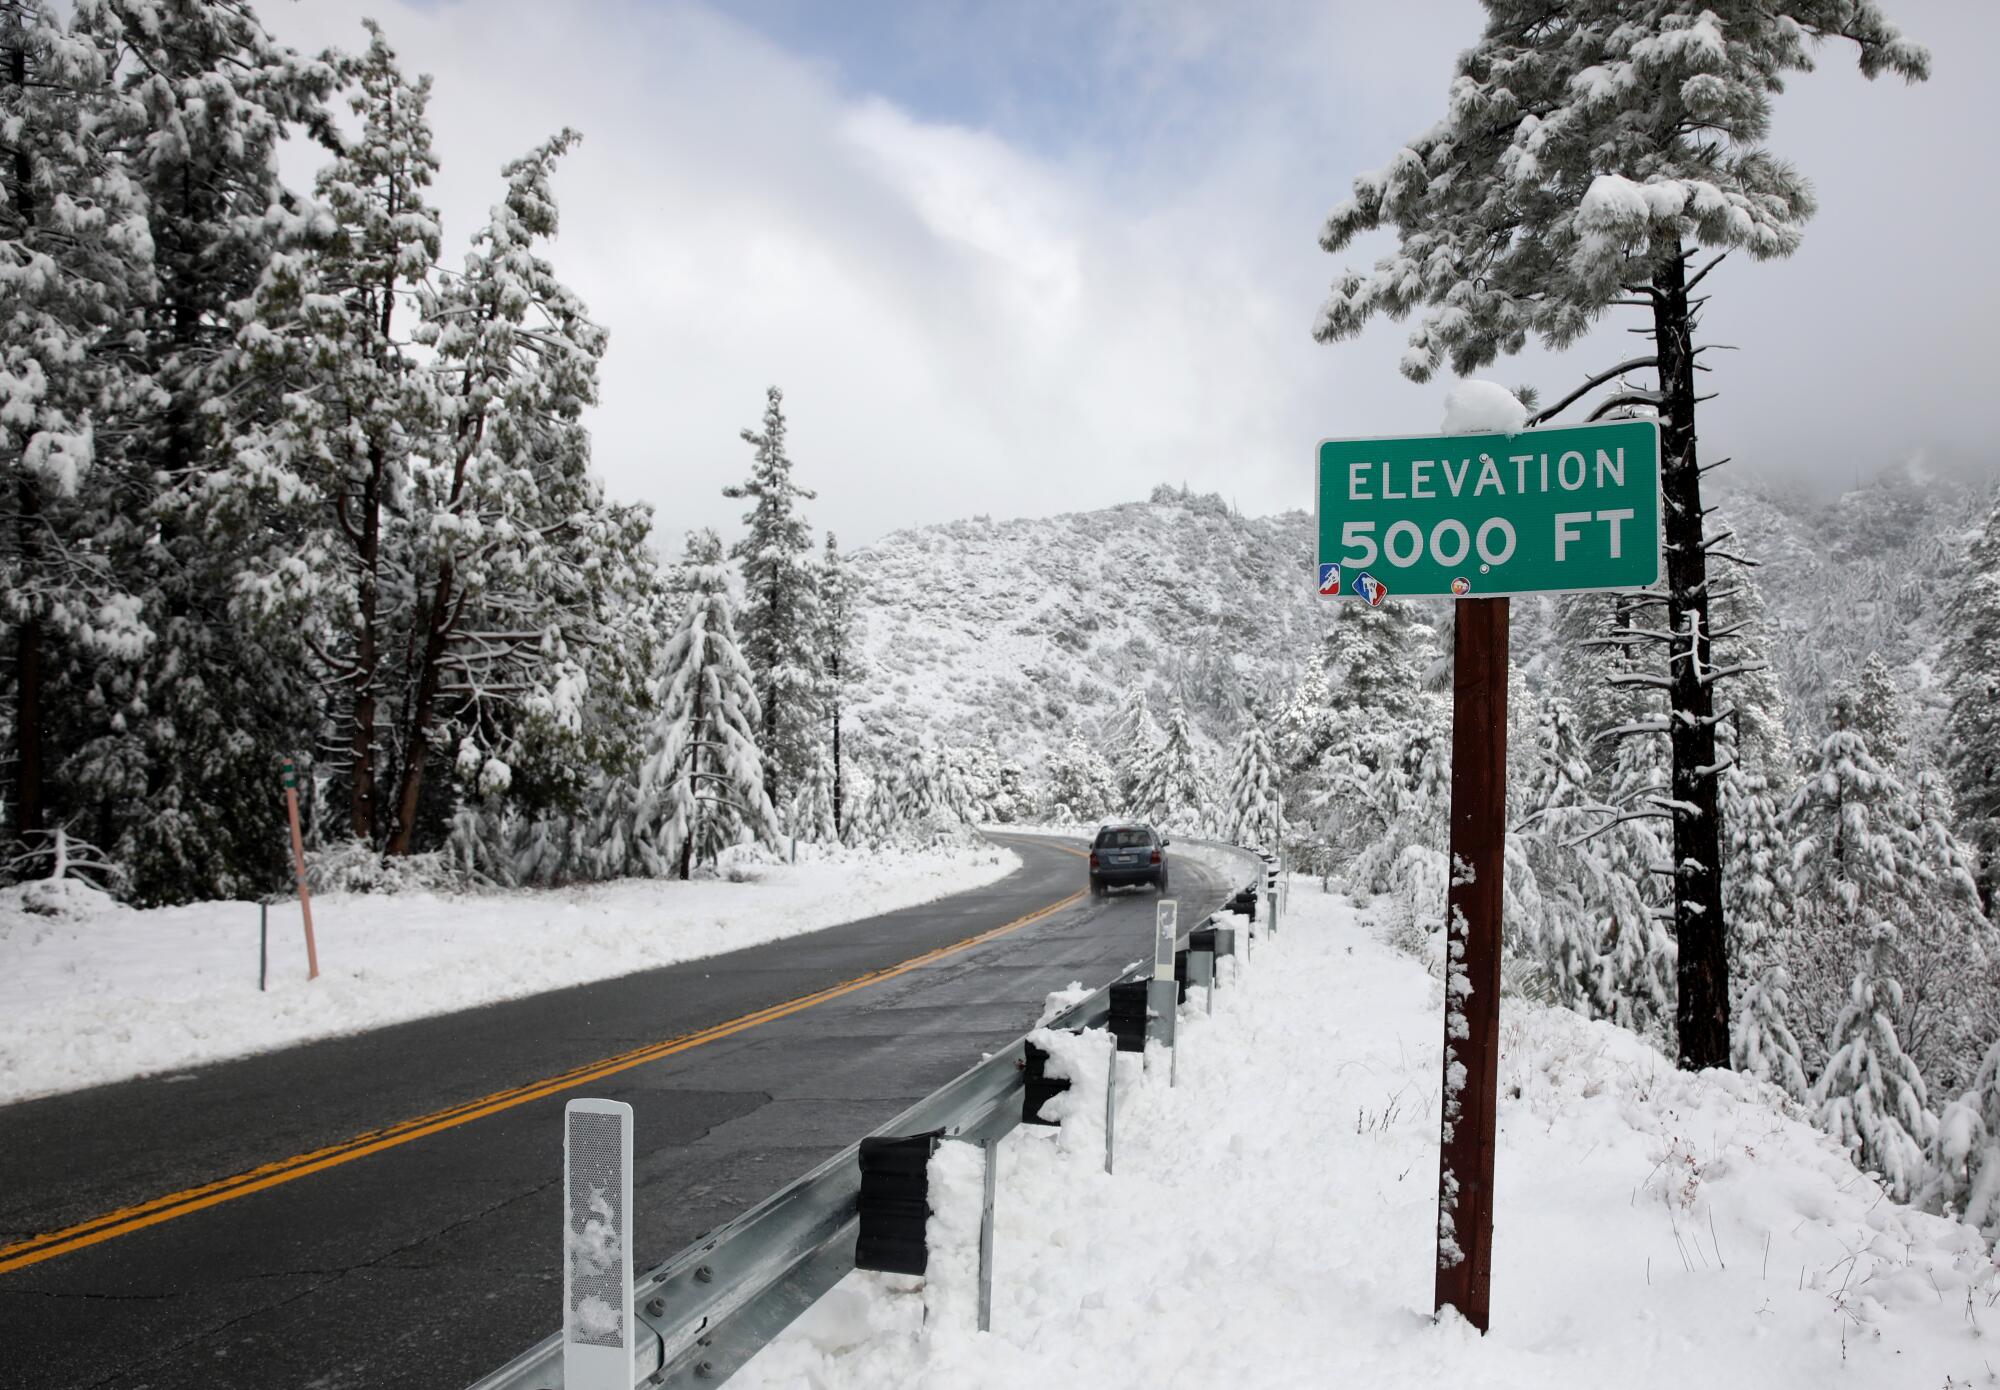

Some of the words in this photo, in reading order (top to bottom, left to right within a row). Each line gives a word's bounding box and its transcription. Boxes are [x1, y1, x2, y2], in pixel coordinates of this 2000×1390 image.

[1349, 447, 1624, 500] ELEVATION
[1340, 516, 1517, 569] 5000
[1554, 508, 1635, 562] FT
